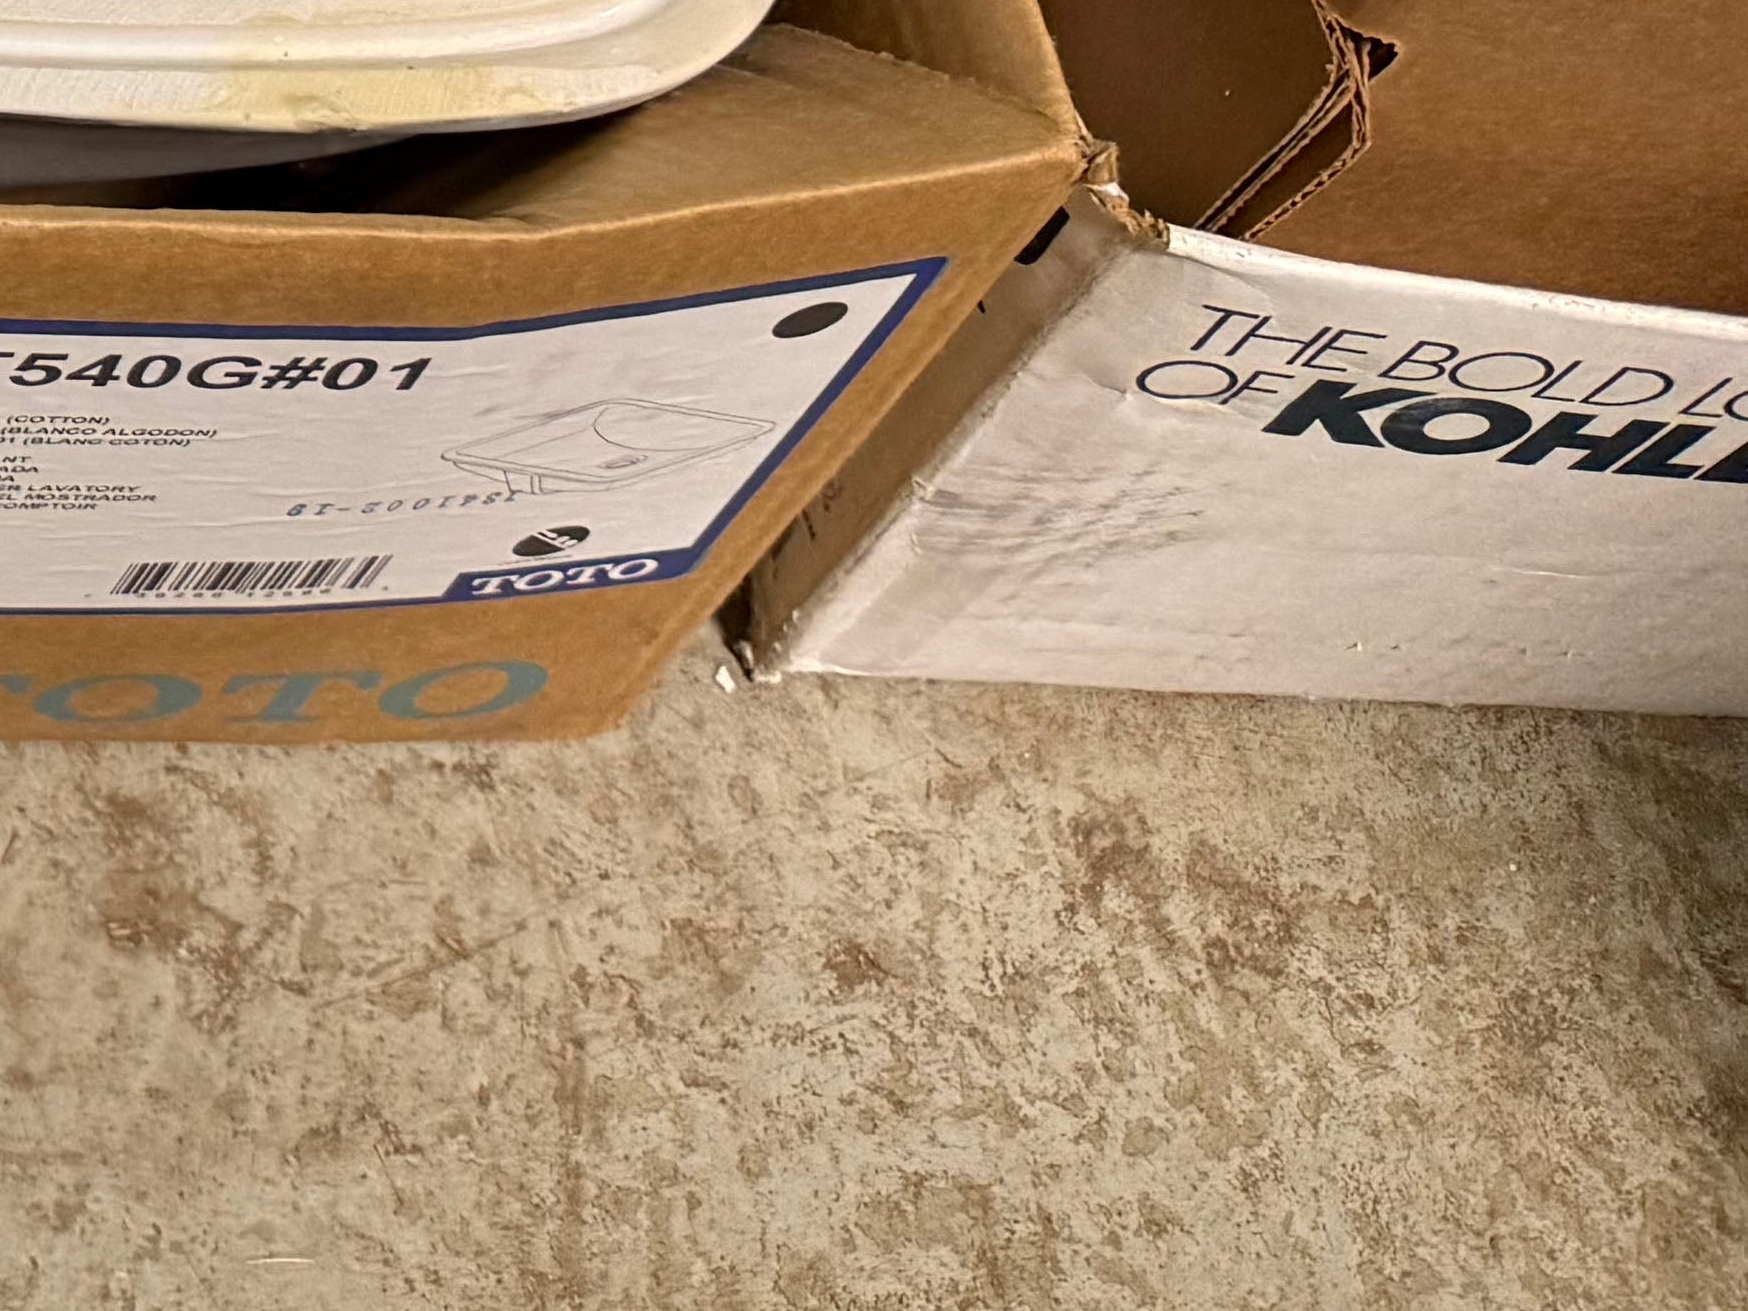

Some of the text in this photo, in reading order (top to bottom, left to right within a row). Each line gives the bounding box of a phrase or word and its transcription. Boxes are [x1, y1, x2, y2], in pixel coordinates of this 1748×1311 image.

[1189, 304, 1387, 373] THE
[1377, 339, 1675, 407] BOLD
[1135, 360, 1296, 405] OF
[7, 414, 111, 426] (COTTON)
[0, 426, 98, 436] (BLANCO
[101, 428, 218, 439] ALGODON)
[22, 436, 103, 446] (BLANC
[108, 439, 191, 448] COTON)
[27, 485, 144, 493] LAVATORY
[24, 493, 159, 502] MOSTRADOR
[471, 558, 660, 595] TOTO
